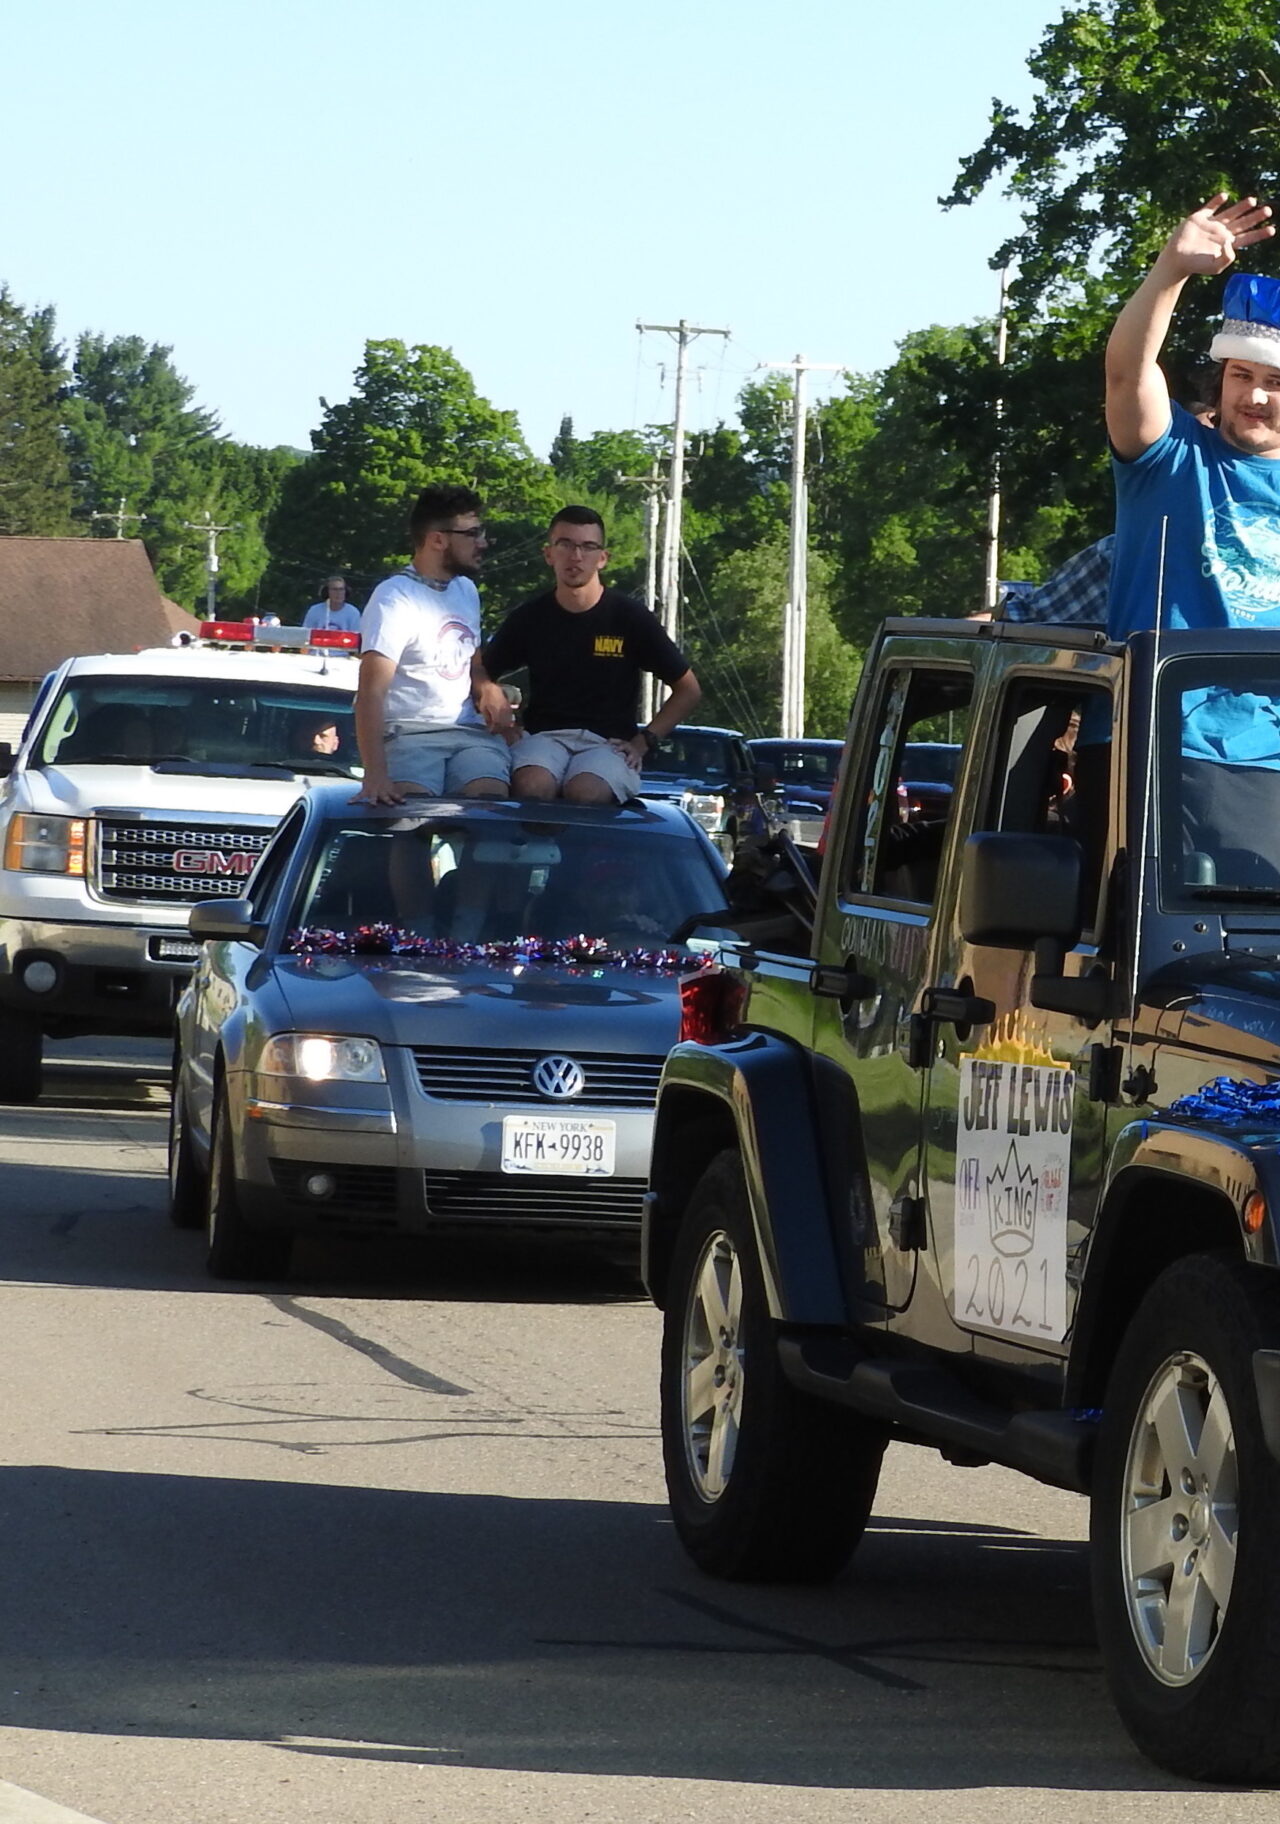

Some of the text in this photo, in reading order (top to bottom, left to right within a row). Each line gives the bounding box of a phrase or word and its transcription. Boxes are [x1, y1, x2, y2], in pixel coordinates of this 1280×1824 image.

[595, 638, 624, 653] NAVY
[1007, 1065, 1073, 1137] LEWIS
[532, 1121, 588, 1133] NEW YORK
[993, 1186, 1033, 1230] KING
[965, 1253, 1053, 1332] 2021
